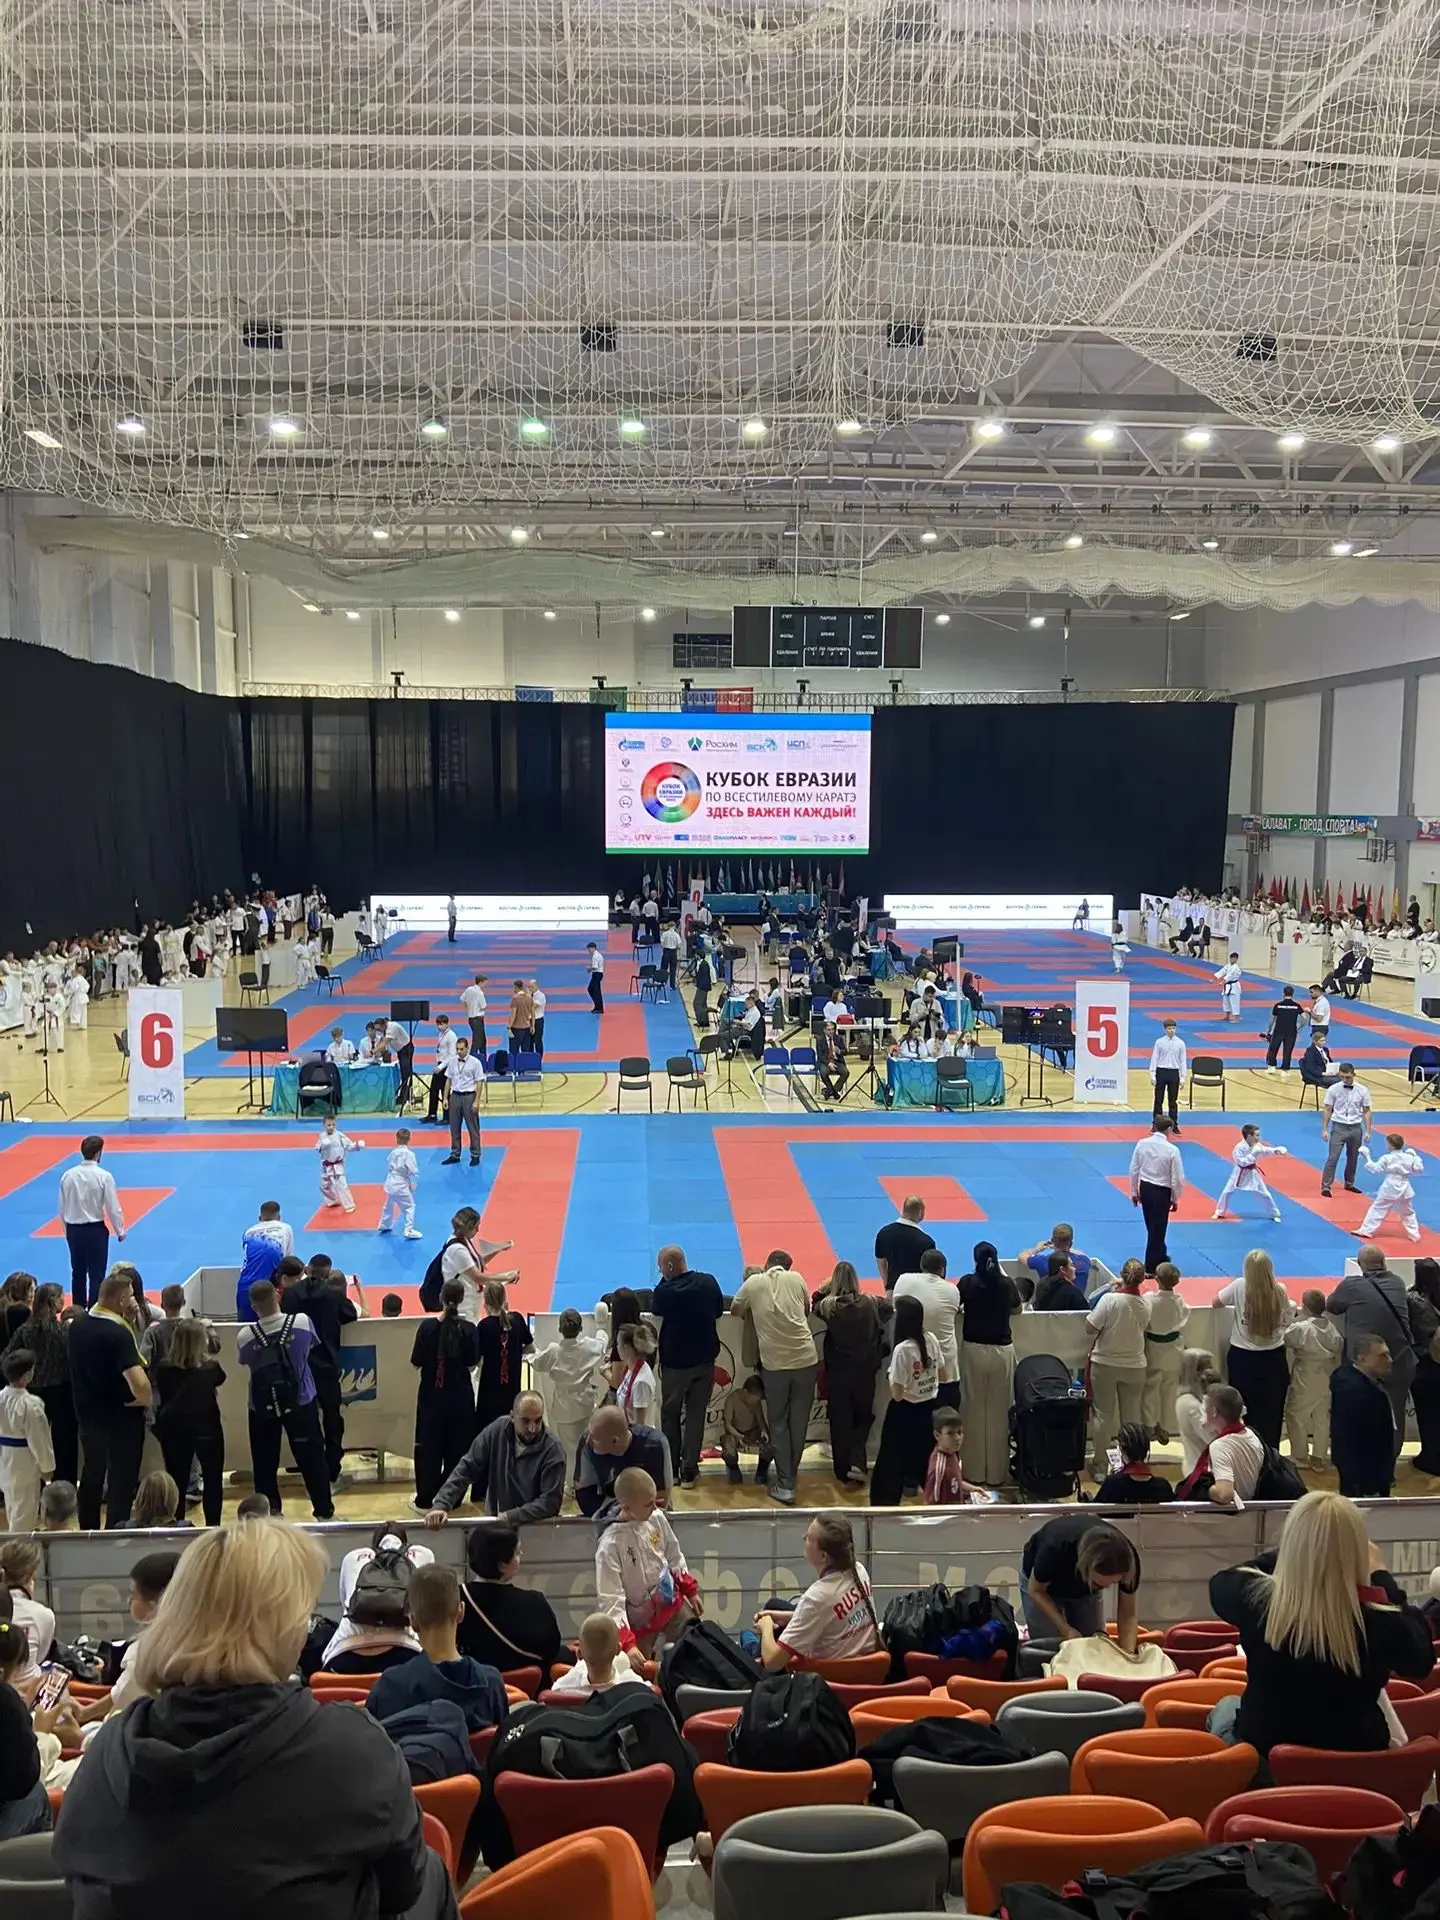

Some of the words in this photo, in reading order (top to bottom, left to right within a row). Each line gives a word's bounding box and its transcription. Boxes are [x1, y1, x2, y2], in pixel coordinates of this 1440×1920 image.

[706, 772, 769, 788] КУБОК
[776, 772, 857, 787] ЕВРАЗИИ
[706, 792, 721, 802] ПО
[725, 792, 813, 802] ВСЕСТИЛЕВОМУ
[816, 792, 857, 802] КАРАТЭ
[706, 807, 744, 819] ЗДЕСЬ
[747, 807, 790, 818] ВАЖЕН
[794, 805, 857, 819] КАЖДЫЙ!
[1261, 818, 1292, 830] САЛАВАТ
[1299, 818, 1323, 833] ГОРОД
[1325, 818, 1359, 833] СПОРТА!
[1087, 1006, 1119, 1058] 5
[141, 1013, 174, 1069] 6
[833, 1581, 873, 1620] RUSI
